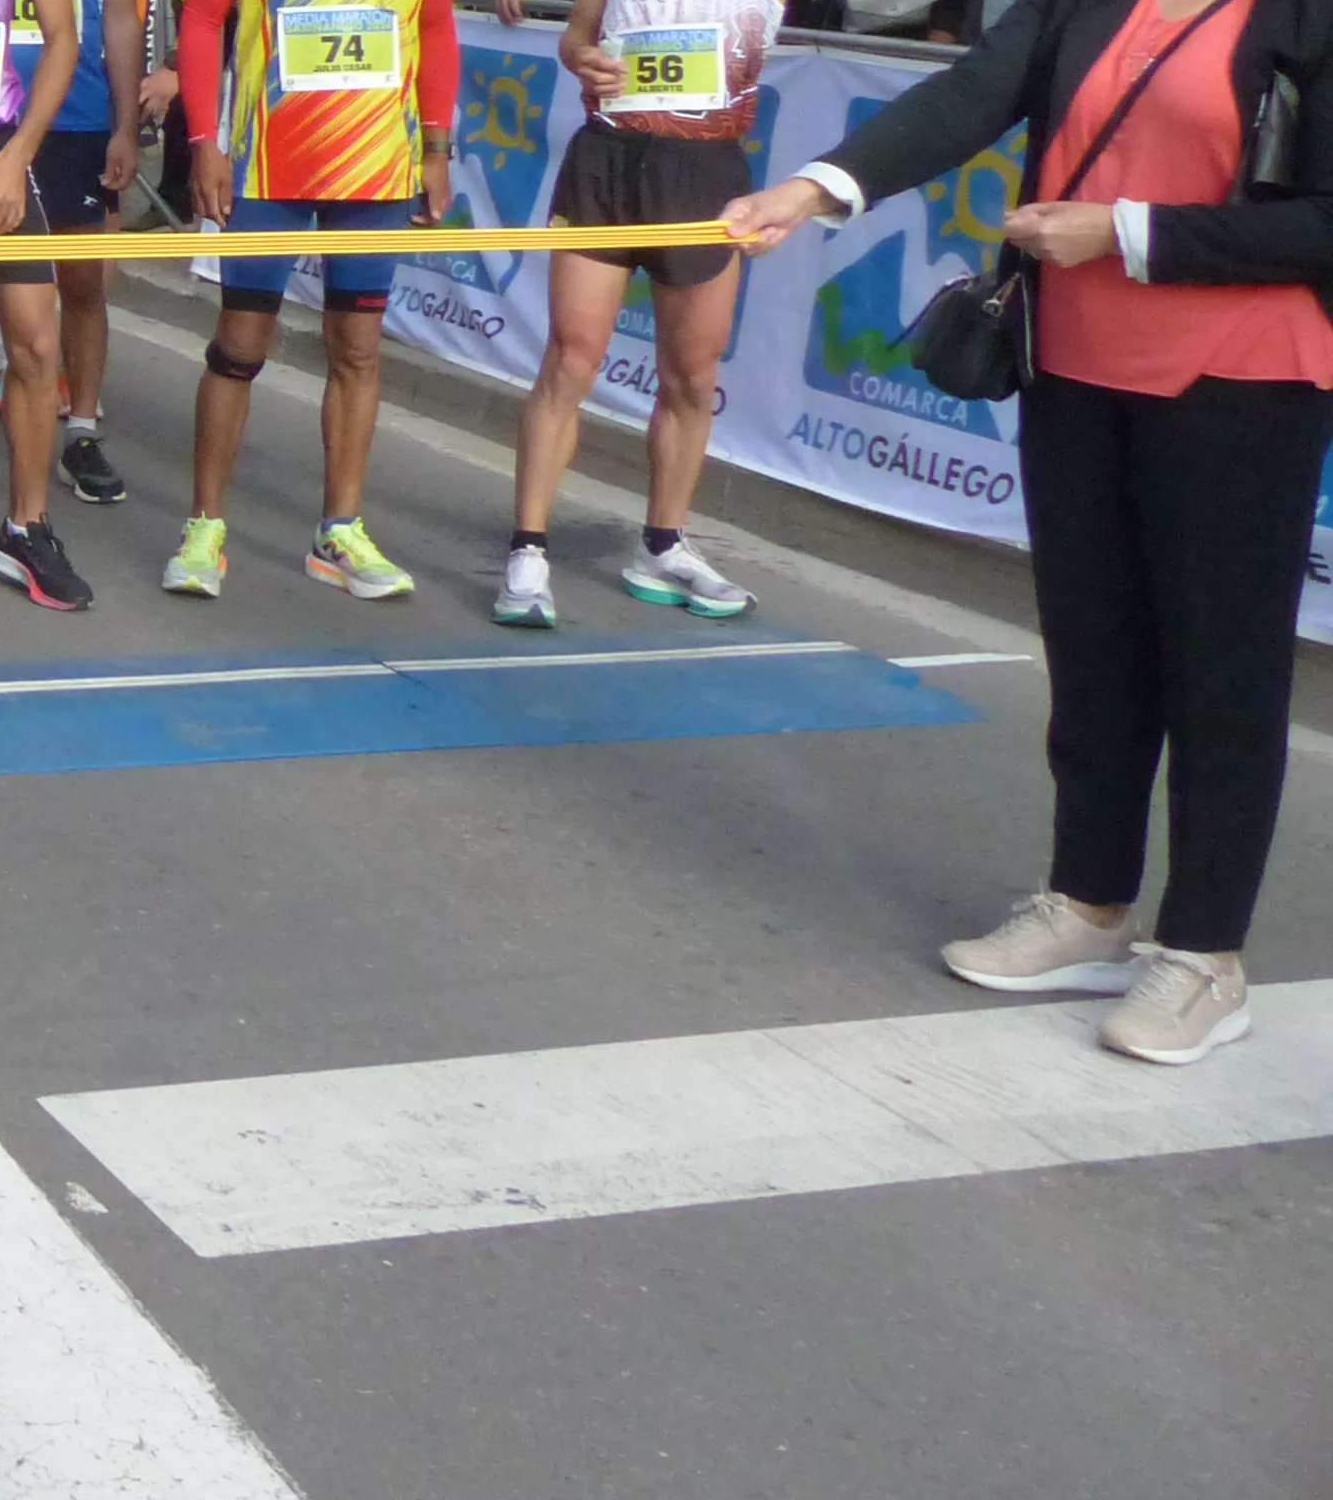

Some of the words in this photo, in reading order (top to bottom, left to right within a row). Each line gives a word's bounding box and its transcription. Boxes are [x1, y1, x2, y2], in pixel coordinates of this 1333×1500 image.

[320, 34, 365, 63] 74
[636, 54, 684, 84] 56
[636, 84, 683, 93] ALBERTO
[849, 371, 969, 427] COMARCA
[785, 412, 1015, 505] ALTOGÁLLEGO
